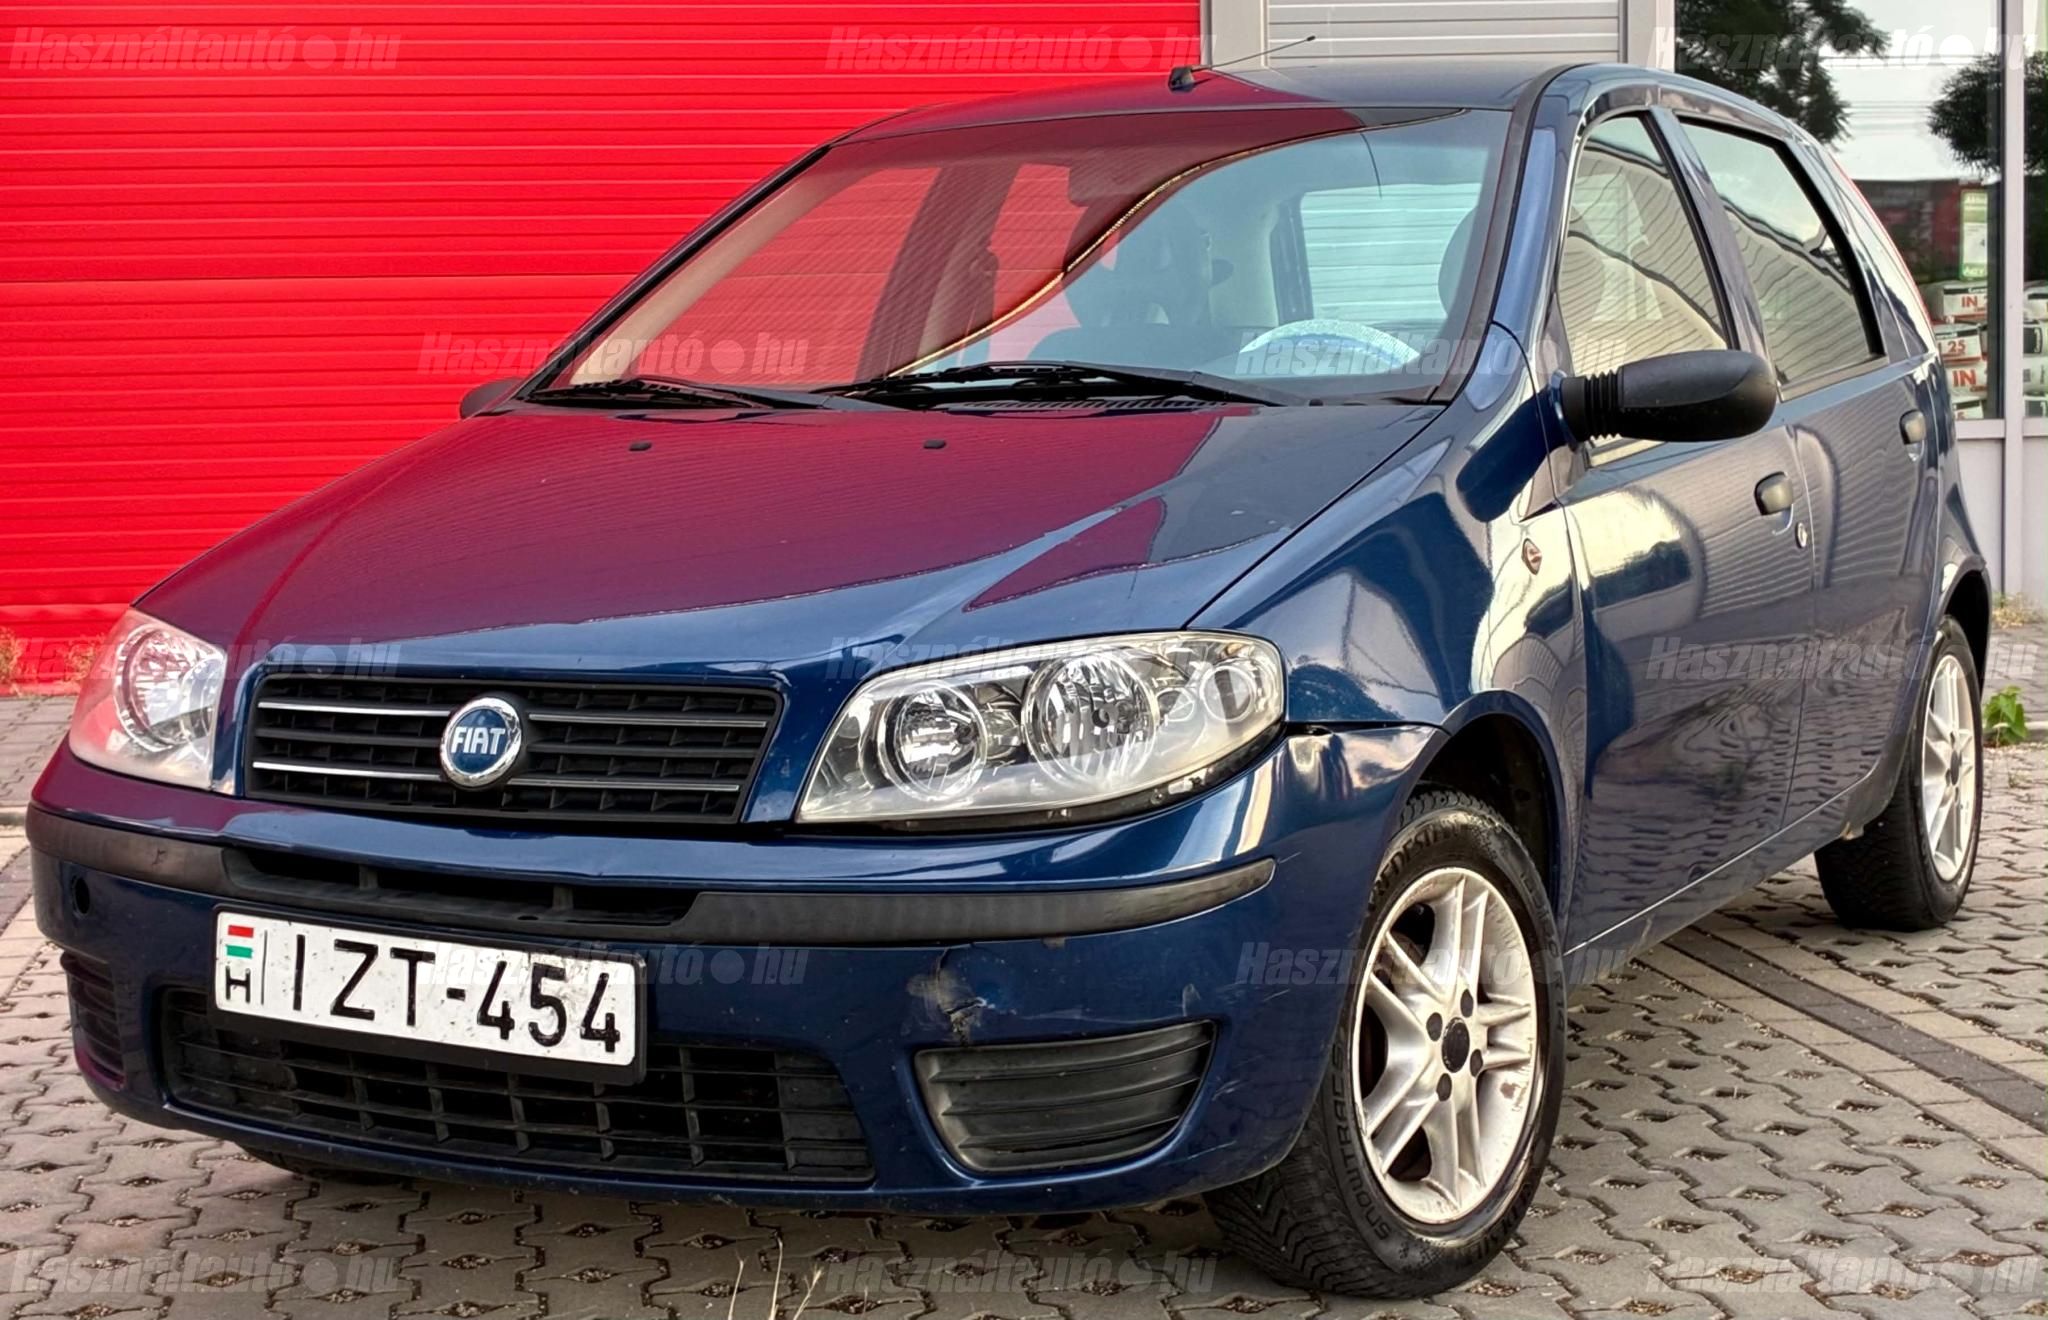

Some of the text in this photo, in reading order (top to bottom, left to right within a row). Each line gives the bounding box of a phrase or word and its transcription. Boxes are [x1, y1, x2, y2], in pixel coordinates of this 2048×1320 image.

[1952, 369, 1977, 388] IN
[451, 726, 506, 755] FIAT
[224, 965, 252, 1004] H
[292, 933, 621, 1053] IZT-454
